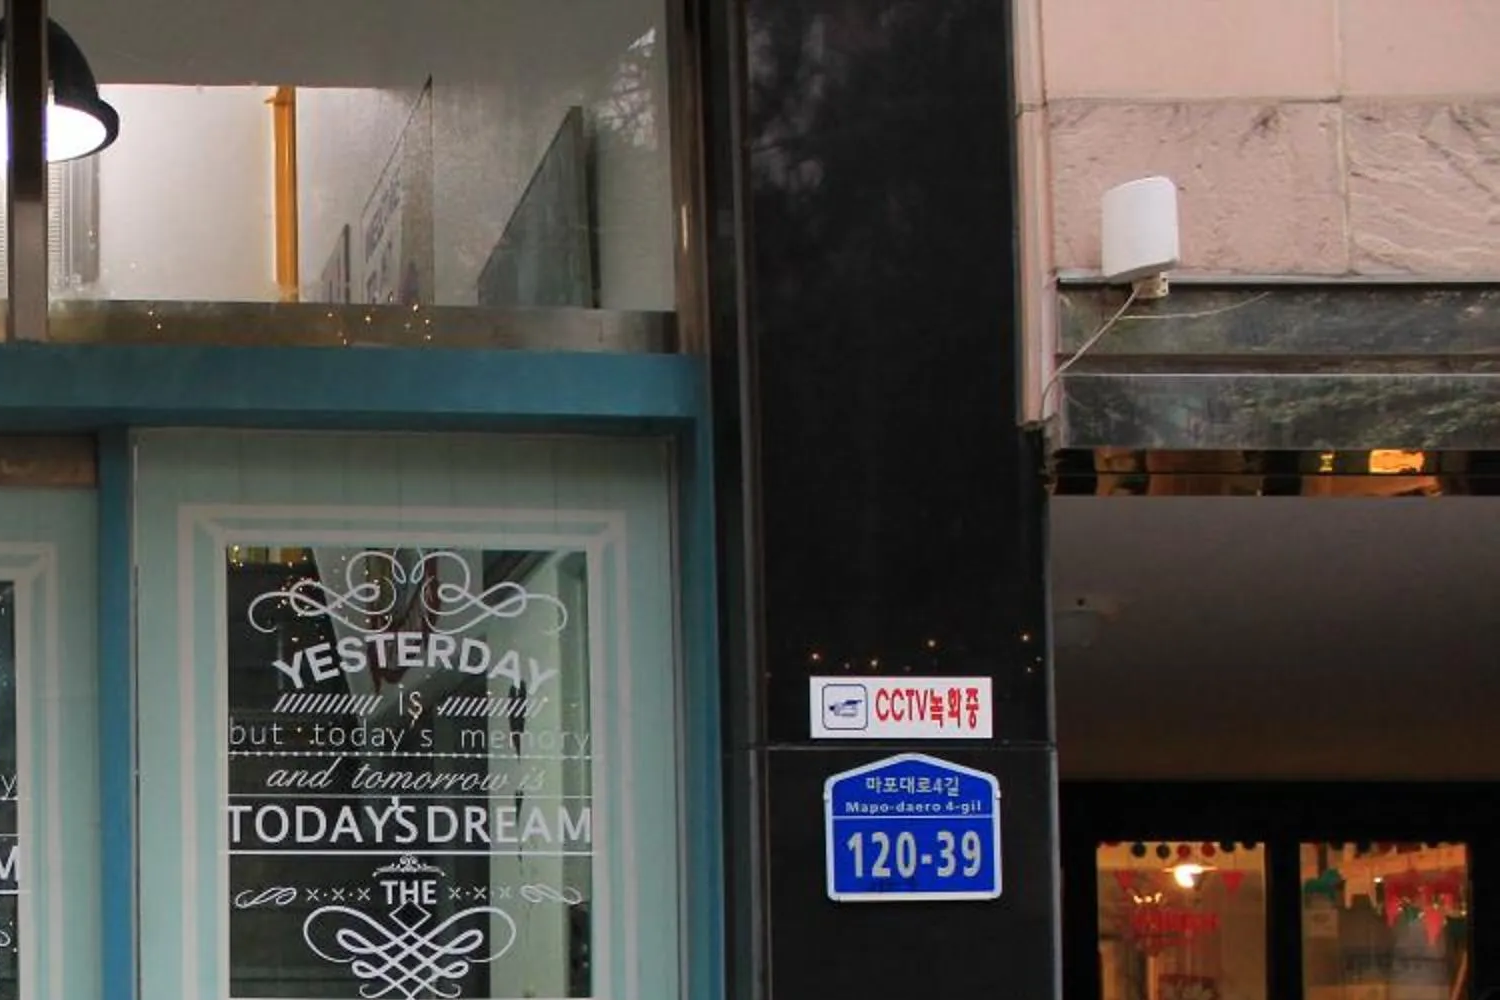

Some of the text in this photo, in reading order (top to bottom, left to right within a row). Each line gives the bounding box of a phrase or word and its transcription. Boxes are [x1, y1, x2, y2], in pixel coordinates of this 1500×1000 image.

[273, 631, 558, 696] YESTERDAY
[399, 684, 423, 717] is
[229, 716, 284, 746] but
[460, 724, 590, 751] memory
[266, 756, 546, 791] and tomorrow is
[427, 804, 591, 844] DREAM
[845, 800, 982, 815] Mapo-daero 4-gil
[846, 831, 982, 878] 120-39
[380, 880, 437, 906] THE
